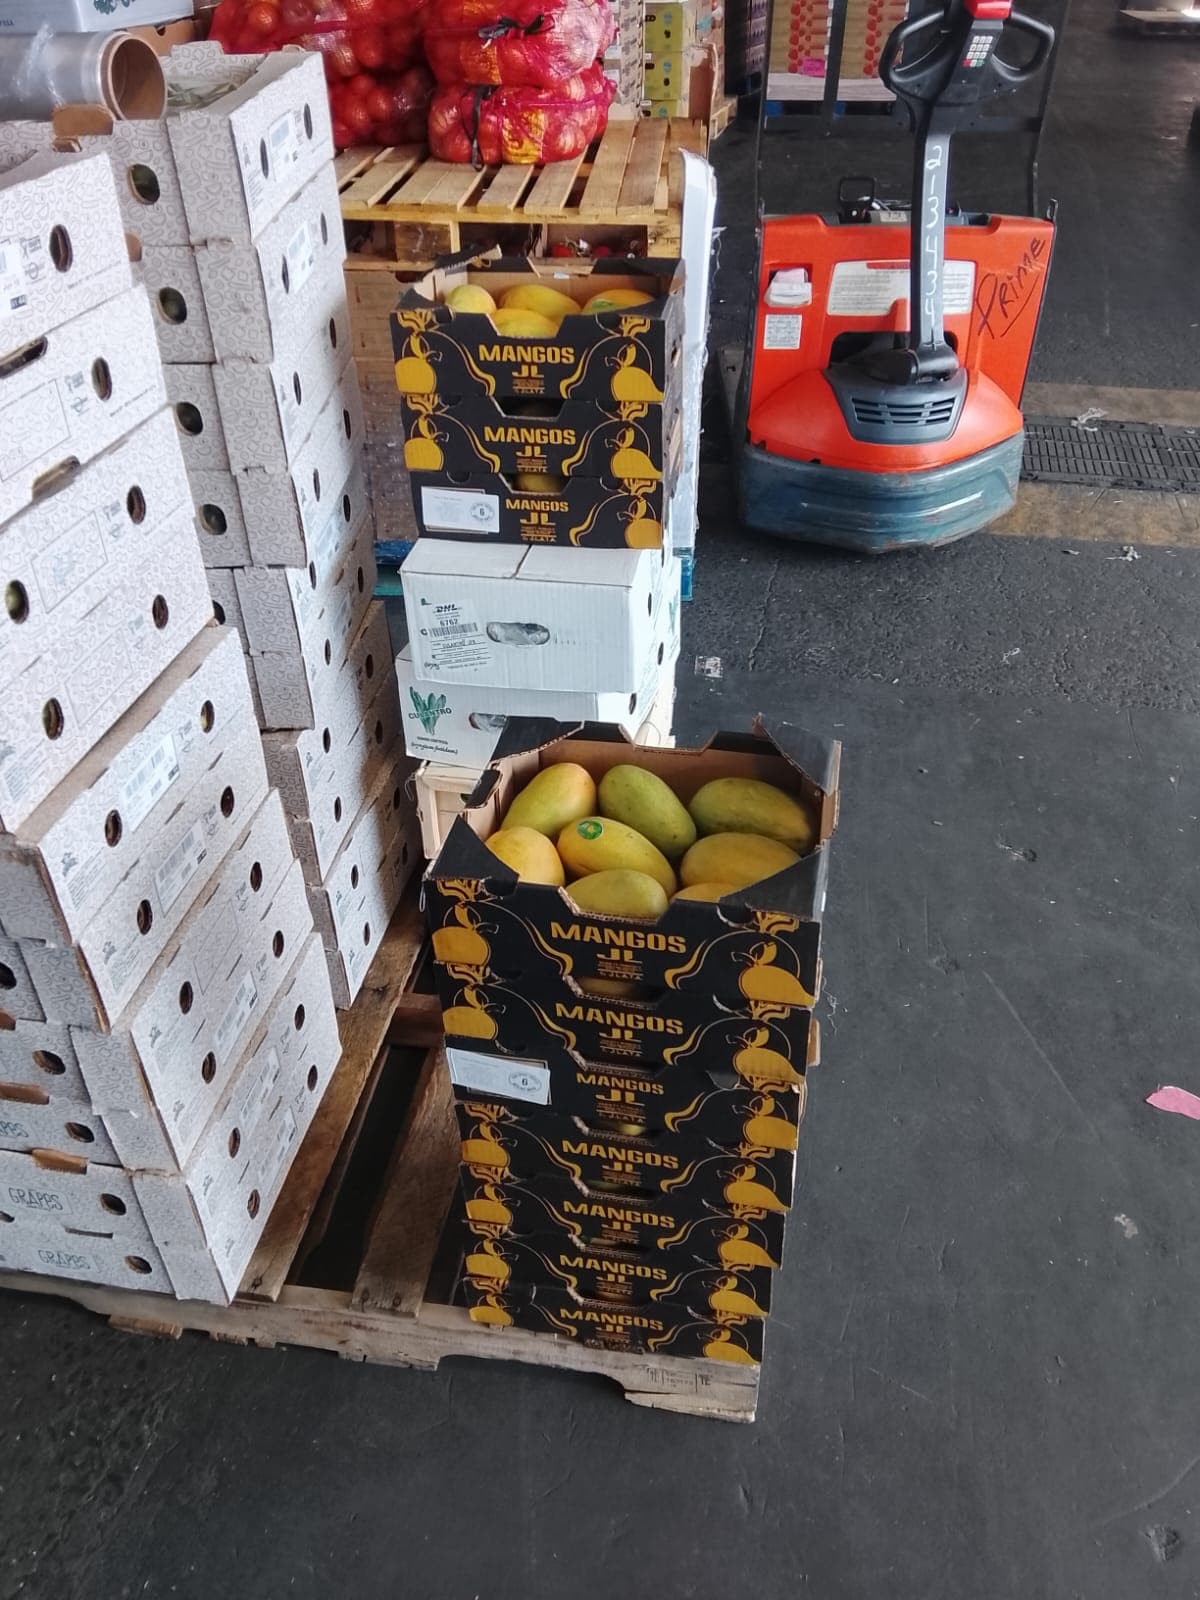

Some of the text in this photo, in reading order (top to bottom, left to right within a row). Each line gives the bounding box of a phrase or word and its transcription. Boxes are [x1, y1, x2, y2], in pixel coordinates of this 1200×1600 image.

[479, 345, 575, 364] MANGOS
[512, 365, 545, 378] JL
[484, 427, 576, 445] MANGOS
[515, 445, 547, 458] JL
[505, 498, 569, 512] MANGOS
[519, 512, 556, 525] JL
[435, 604, 457, 613] DHL
[550, 921, 687, 954] MANGOS
[596, 948, 643, 963] JL
[555, 1002, 684, 1035] MANGOS
[598, 1028, 642, 1043] JL
[576, 1072, 665, 1095] MANGOS
[595, 1088, 646, 1106] JL
[562, 1139, 679, 1169] MANGOS
[563, 1200, 676, 1229] MANGOS
[559, 1254, 668, 1280] MANGOS
[560, 1308, 664, 1331] MANGOS
